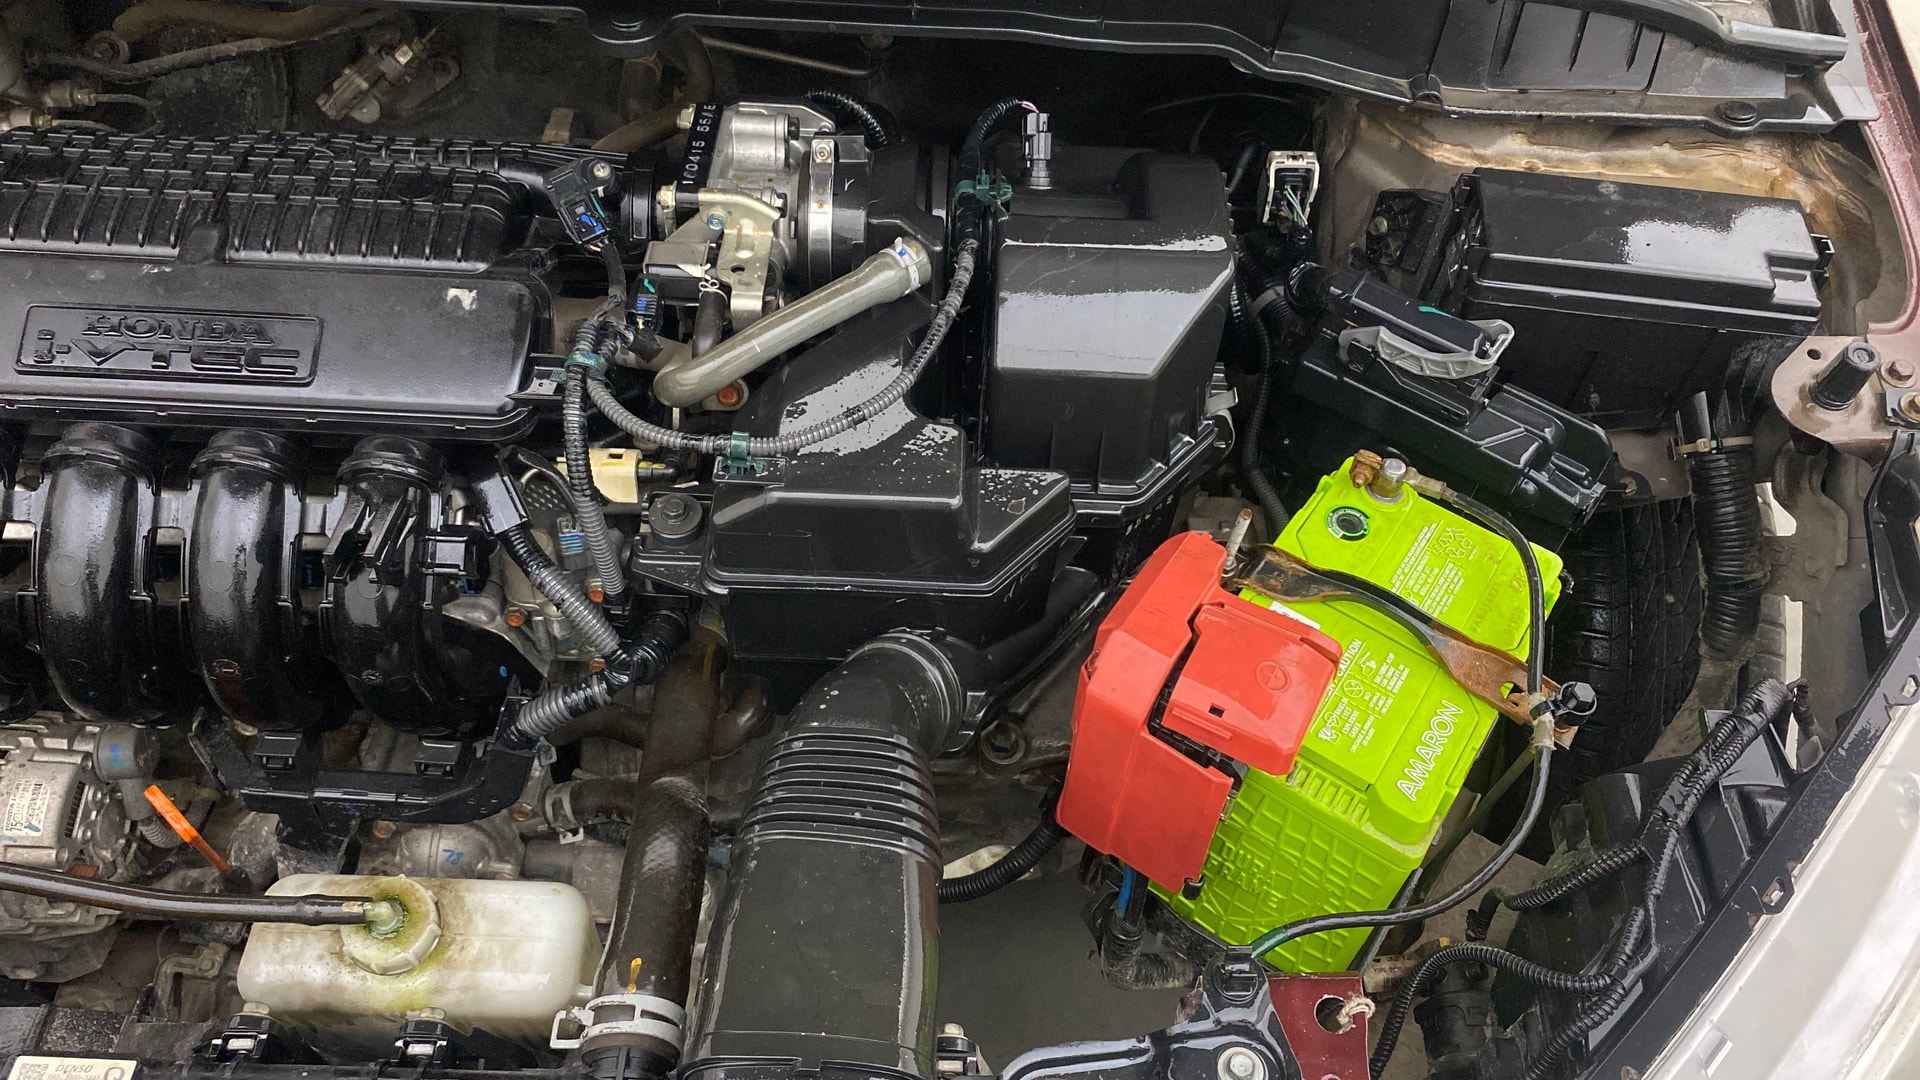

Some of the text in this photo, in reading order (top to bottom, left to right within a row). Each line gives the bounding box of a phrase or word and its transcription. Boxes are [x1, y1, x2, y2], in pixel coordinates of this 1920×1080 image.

[81, 314, 275, 346] HONDA
[33, 328, 300, 376] i-VTEC
[1337, 639, 1362, 677] CAUTION
[1397, 700, 1464, 802] AMARON
[56, 1064, 94, 1074] DENSO
